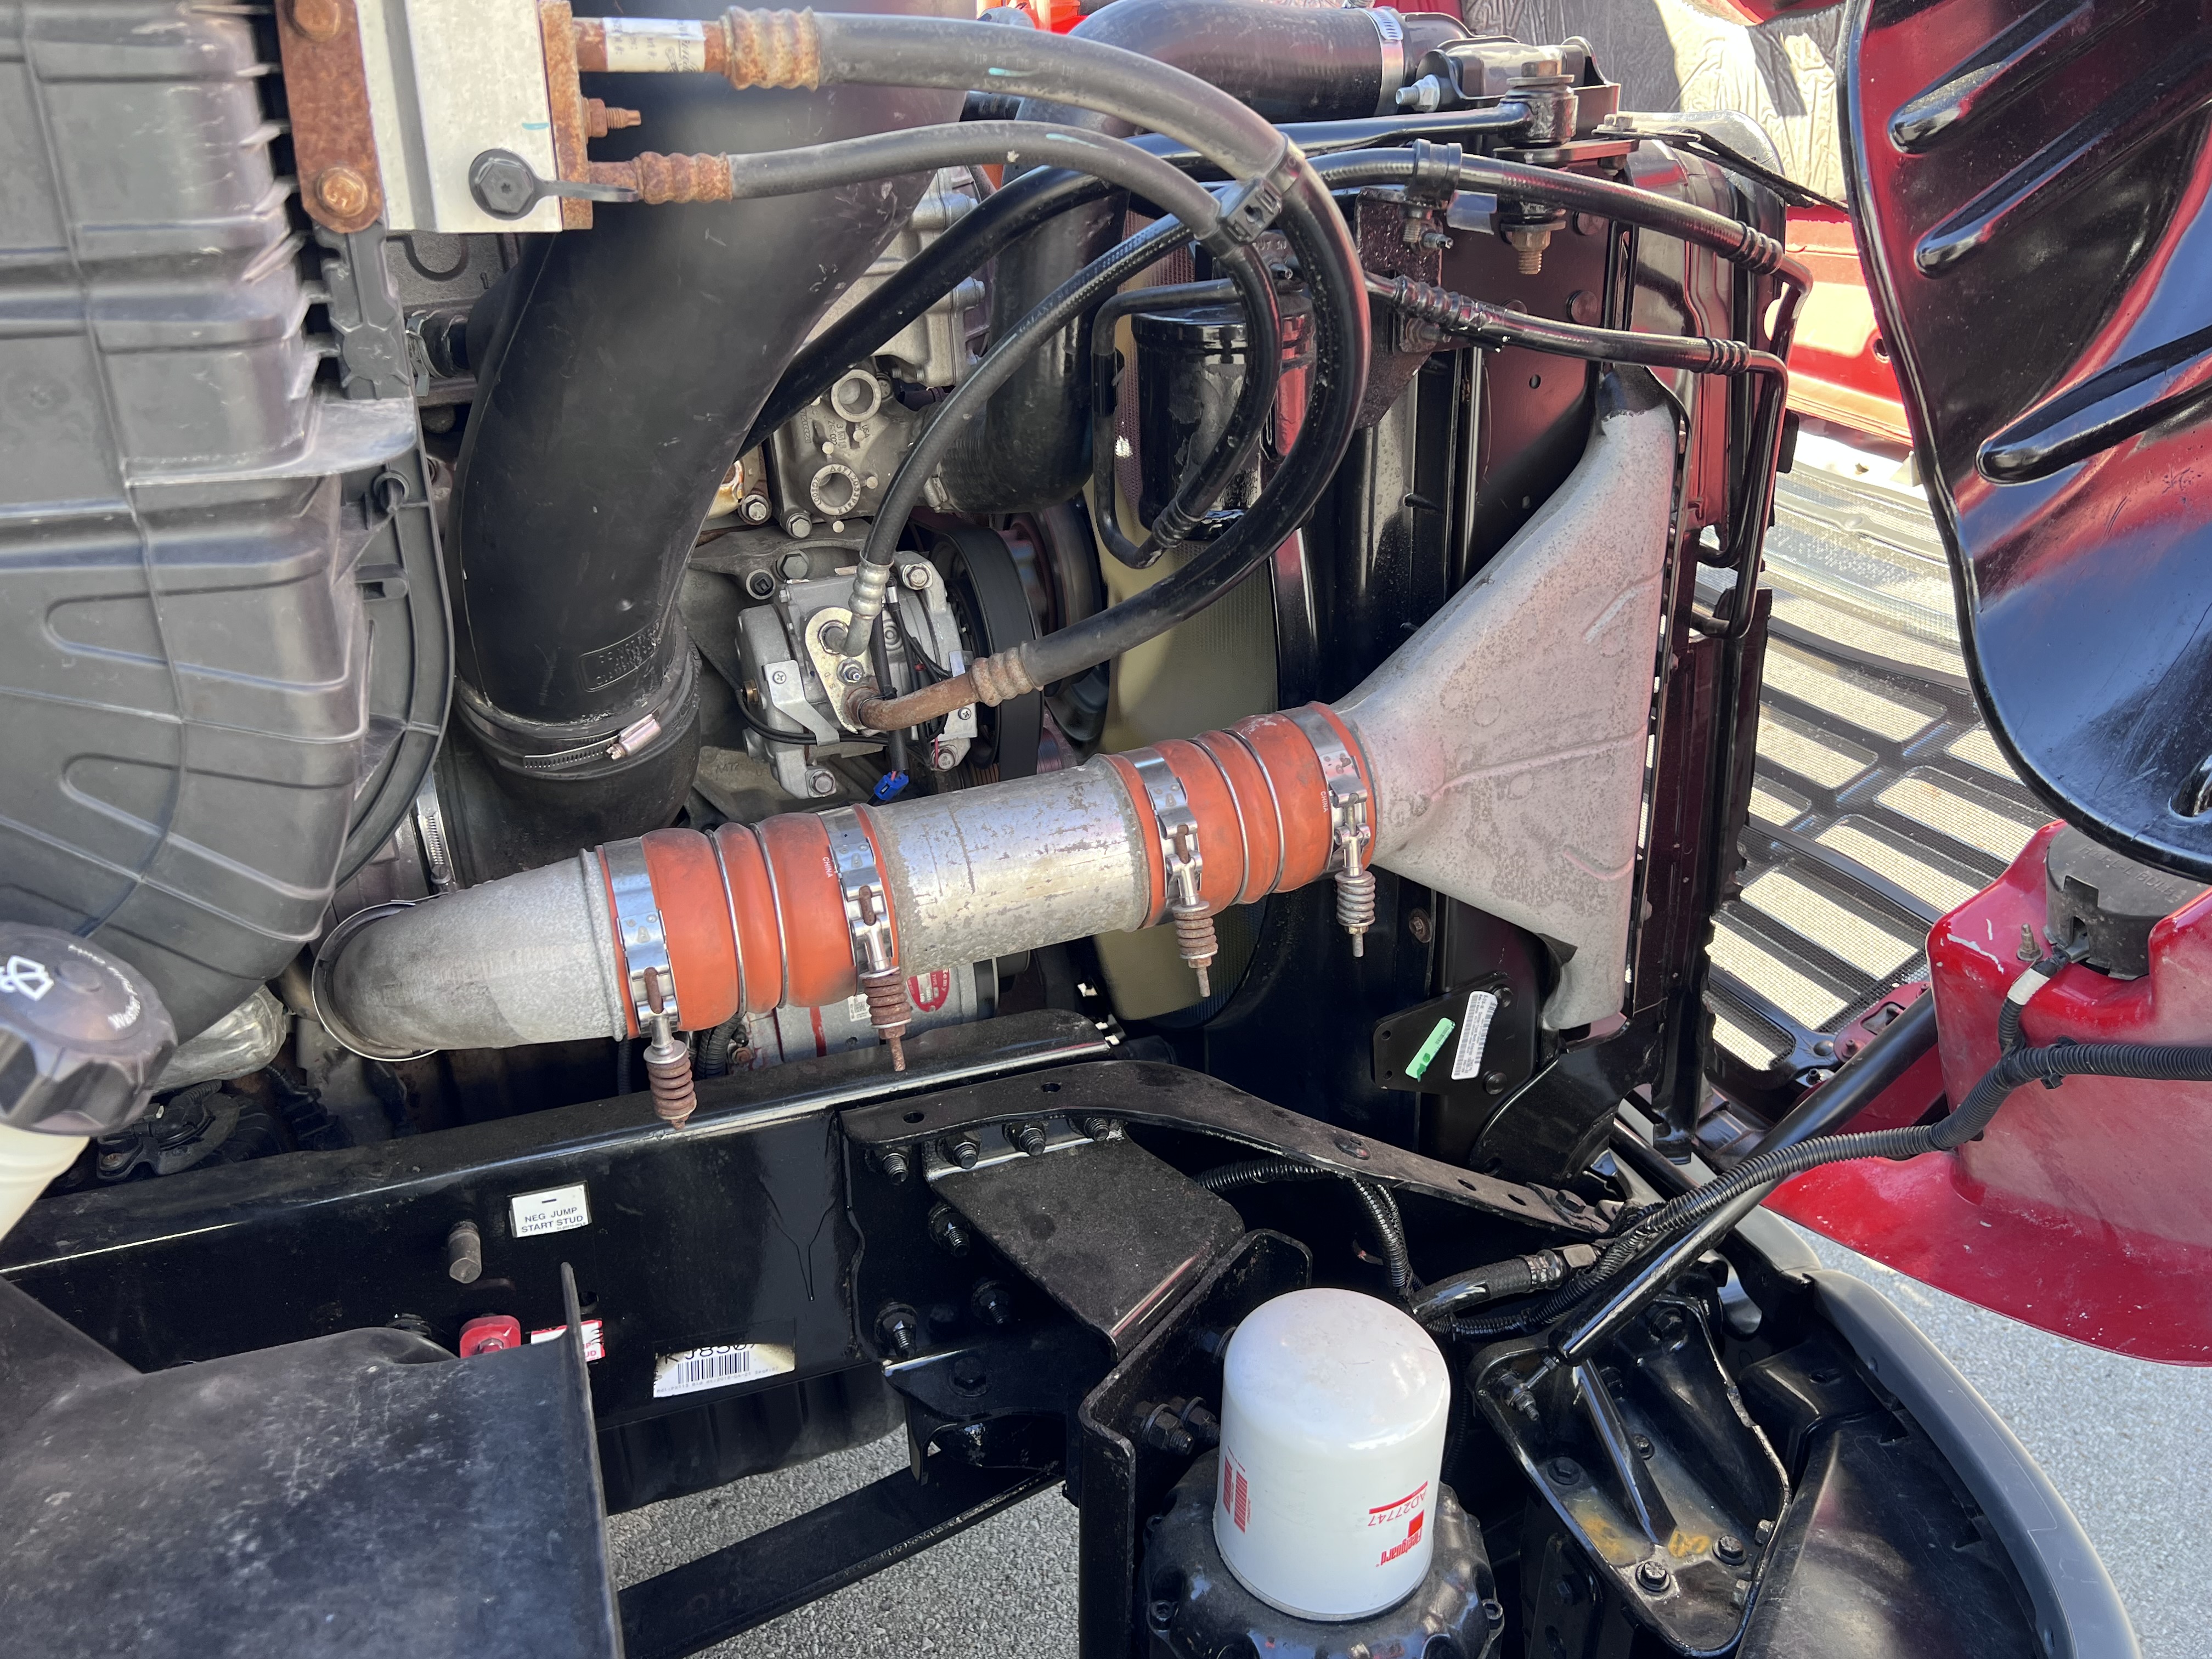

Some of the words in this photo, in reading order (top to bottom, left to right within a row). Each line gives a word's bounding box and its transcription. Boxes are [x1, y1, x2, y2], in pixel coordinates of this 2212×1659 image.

[1019, 298, 1054, 332] GALAXY
[861, 424, 870, 439] USA
[1319, 791, 1329, 814] CHINA
[823, 856, 832, 879] CHINA
[2135, 871, 2177, 897] BULB
[108, 995, 140, 1031] Washer
[521, 1221, 554, 1233] START
[556, 1215, 583, 1226] STUD
[524, 1213, 546, 1223] NEG
[551, 1207, 578, 1218] JUMP
[1368, 1489, 1426, 1527] AD27747
[1380, 1527, 1423, 1566] Fleetguard
